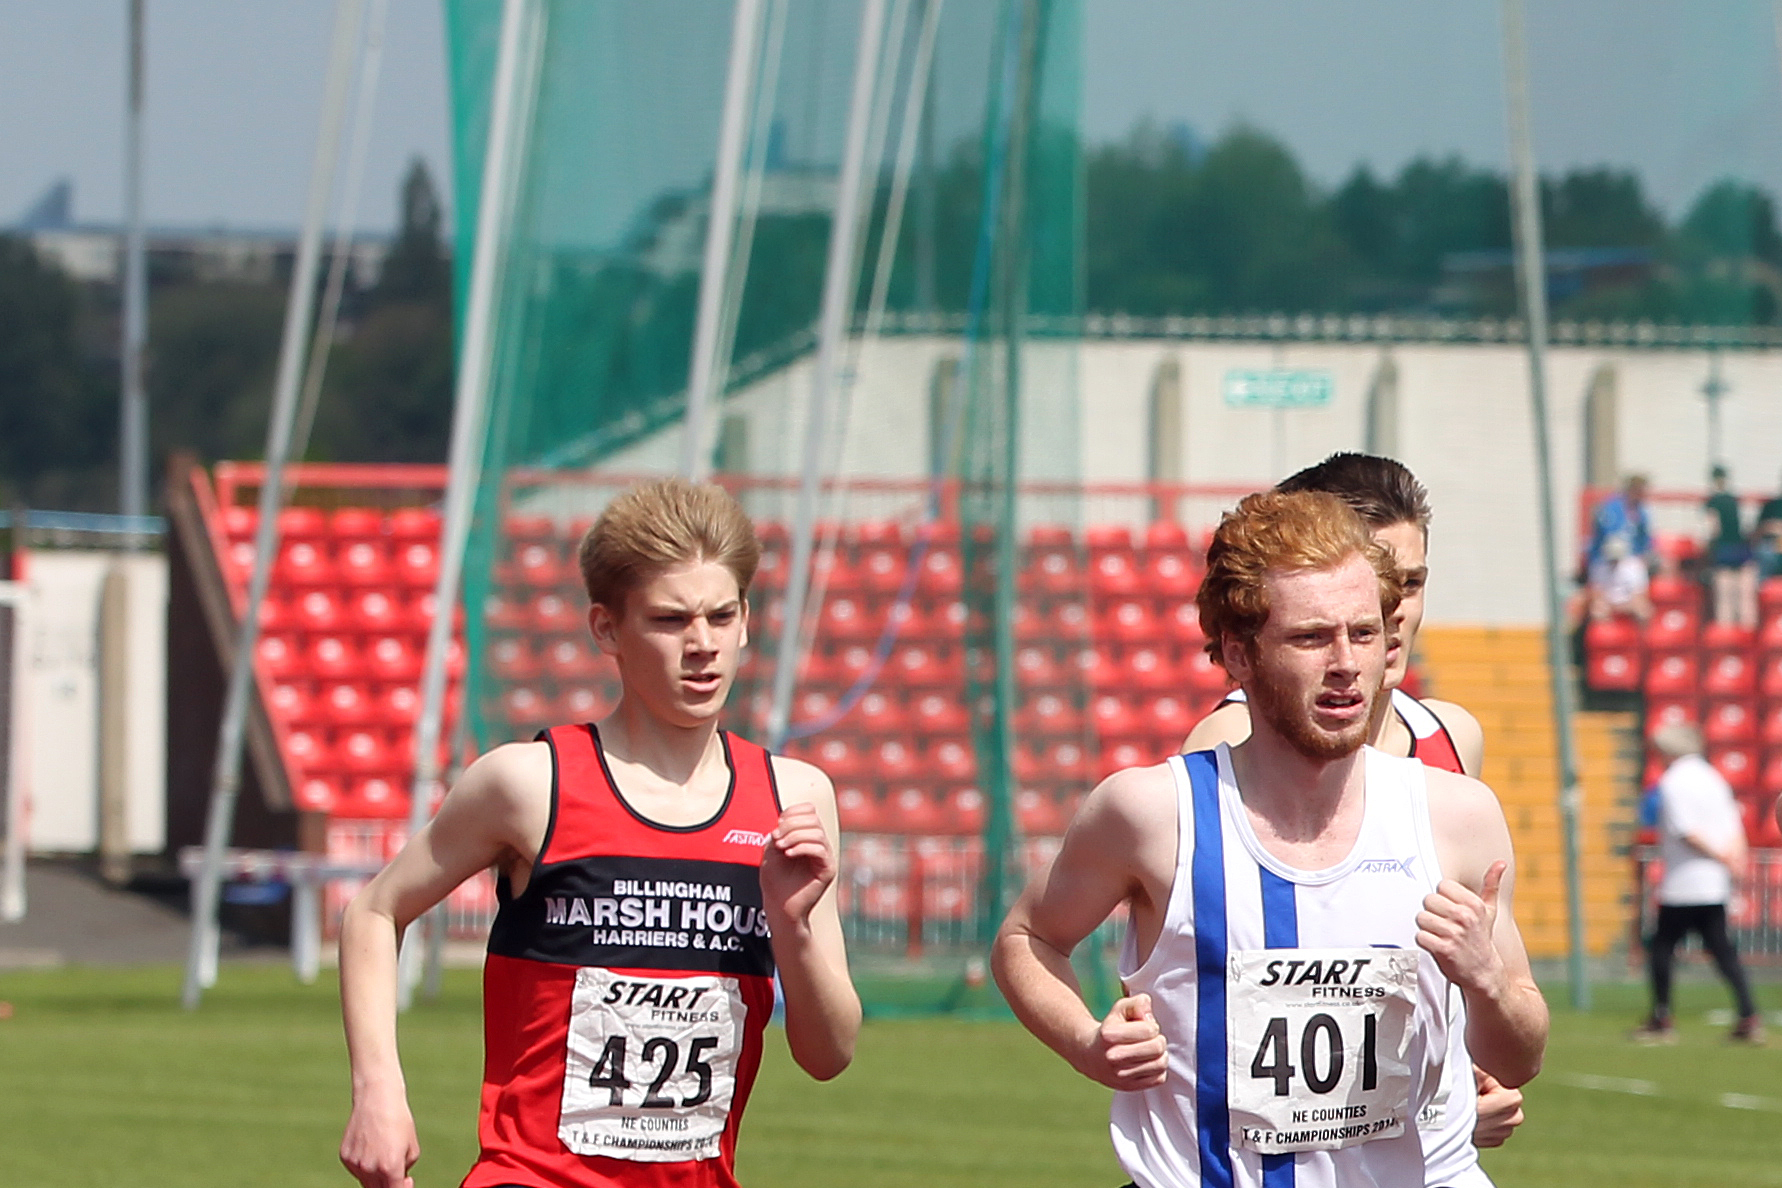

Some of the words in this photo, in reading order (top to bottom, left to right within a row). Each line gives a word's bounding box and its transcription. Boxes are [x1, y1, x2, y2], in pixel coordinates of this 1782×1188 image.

[613, 879, 731, 901] BILLINGHAM
[545, 897, 670, 928] MARSH
[680, 899, 771, 938] HOUS
[593, 929, 689, 948] HARRIERS
[693, 934, 706, 949] &
[709, 934, 744, 952] A.C.
[1259, 959, 1372, 986] START
[603, 981, 709, 1009] START
[1312, 987, 1385, 998] FITNESS
[651, 1010, 719, 1022] FITNESS
[1250, 1013, 1377, 1096] 401
[589, 1036, 719, 1109] 425
[621, 1117, 637, 1130] NE
[640, 1119, 689, 1131] COUNTIES
[1293, 1111, 1308, 1123] NE
[1312, 1105, 1367, 1120] COUNTIES
[603, 1135, 693, 1151] CHAMPIONSHIPS
[1243, 1128, 1250, 1141] T
[1252, 1130, 1262, 1143] &
[1265, 1130, 1273, 1143] F
[1276, 1125, 1370, 1143] CHAMPIONSHIPS
